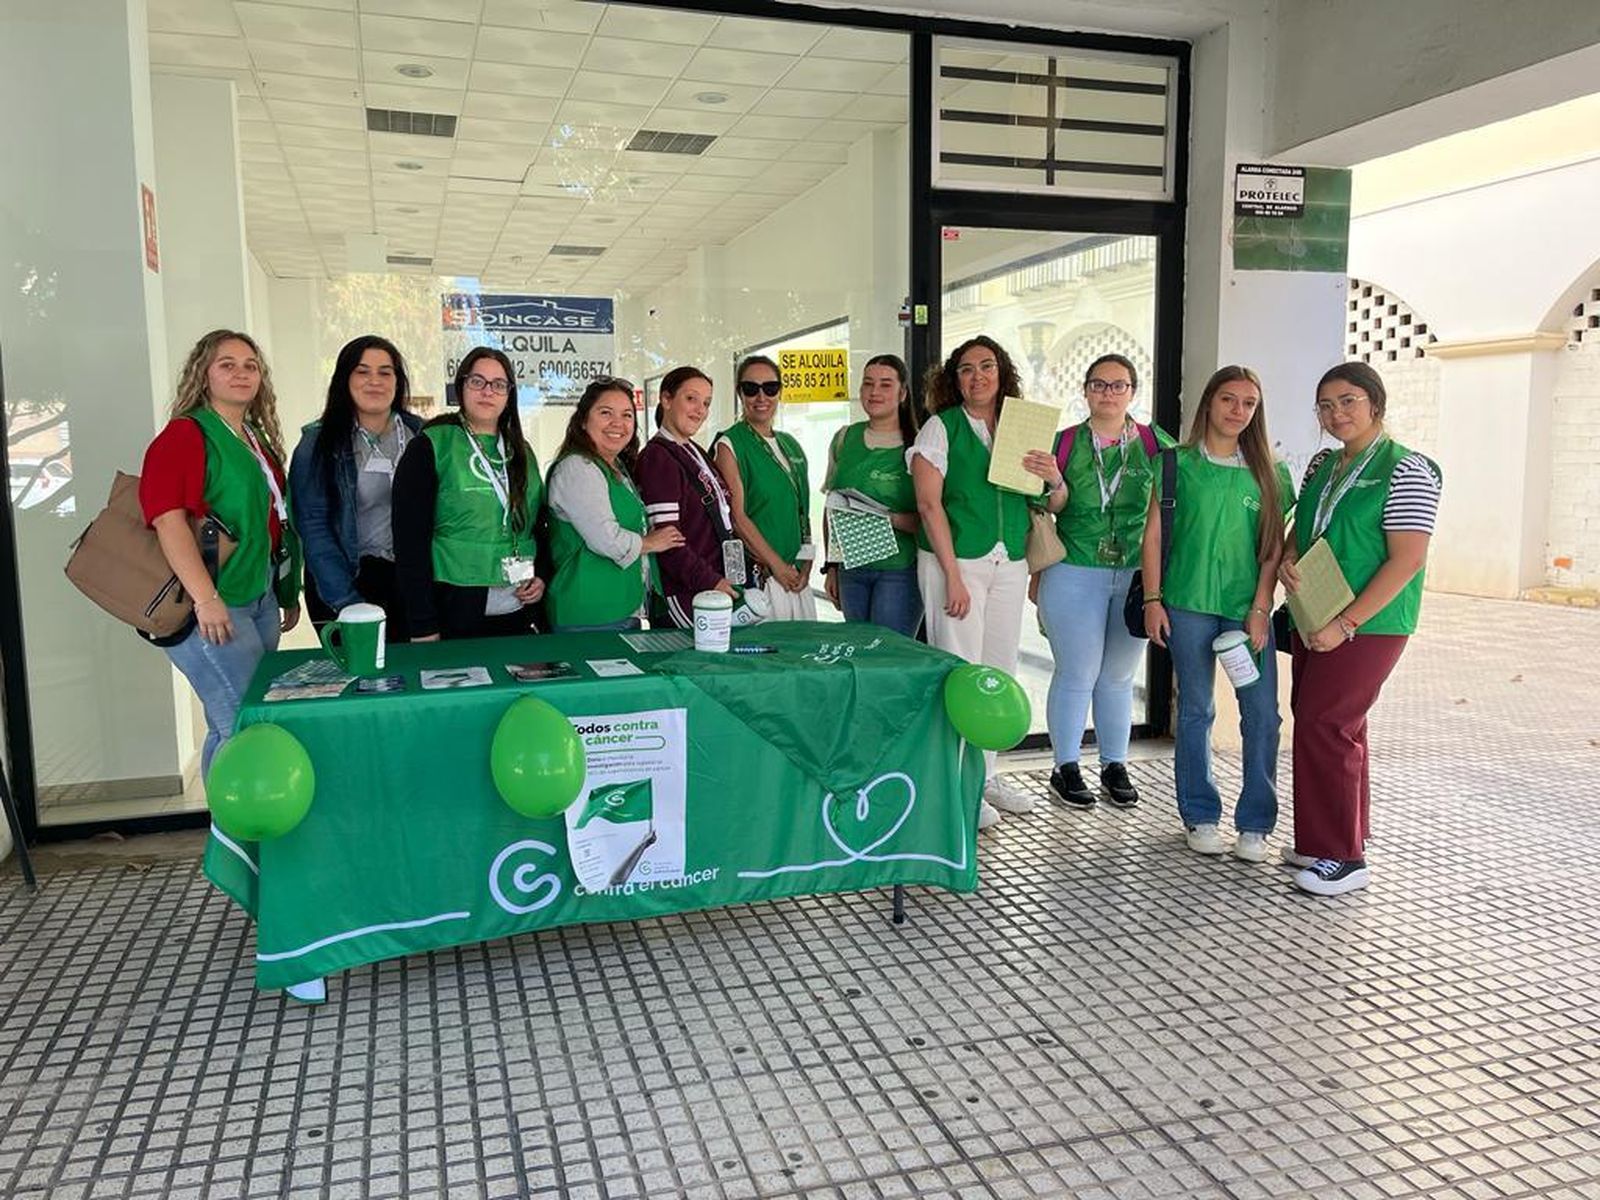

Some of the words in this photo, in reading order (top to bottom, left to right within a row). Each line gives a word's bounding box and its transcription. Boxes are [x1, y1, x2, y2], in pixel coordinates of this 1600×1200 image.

[1240, 190, 1301, 202] PROTELEC
[501, 335, 577, 353] LQUILA
[782, 354, 797, 369] SE
[799, 354, 844, 369] ALQUILA
[804, 372, 817, 388] 85
[819, 372, 831, 387] 21
[835, 372, 845, 386] 11
[613, 720, 659, 732] contra
